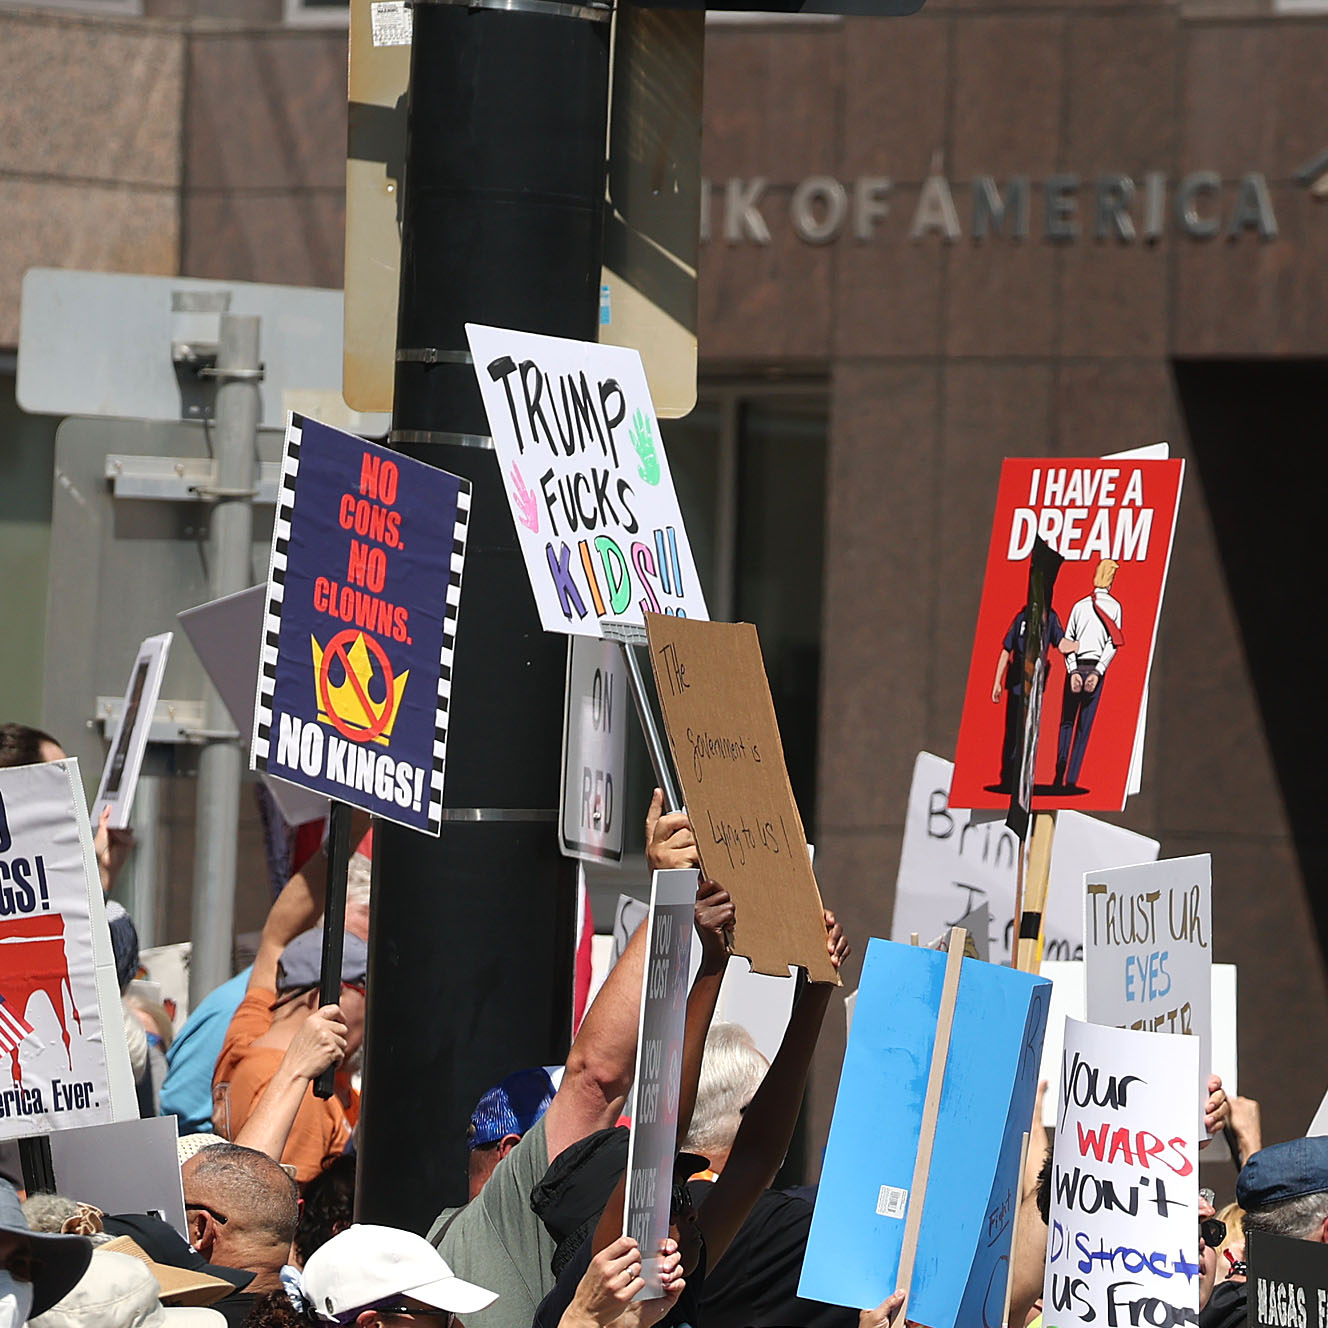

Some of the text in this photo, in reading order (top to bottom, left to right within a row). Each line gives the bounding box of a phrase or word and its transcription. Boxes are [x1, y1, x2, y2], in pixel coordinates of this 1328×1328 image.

[791, 171, 1279, 243] OF AMERICA
[487, 356, 627, 469] TRUMP
[359, 452, 398, 505] NO
[539, 467, 639, 537] FUCKS
[1029, 469, 1143, 506] I HAVE A
[338, 493, 404, 550] CONS.
[1007, 508, 1154, 561] DREAM
[348, 538, 385, 593] NO
[545, 526, 687, 620] KIDS!!
[313, 576, 413, 645] CLOWNS.
[593, 667, 614, 734] ON
[276, 711, 425, 812] NO KINGS!
[748, 740, 761, 763] is
[581, 766, 614, 834] RED
[655, 914, 672, 955] YOU
[1088, 884, 1162, 947] TRUST
[1170, 884, 1208, 949] UR
[650, 959, 670, 1000] LOST
[1126, 951, 1172, 1003] EYES
[645, 1040, 662, 1081] YOU
[52, 1078, 101, 1110] Ever.
[639, 1084, 660, 1125] LOST
[1077, 1120, 1194, 1177] WARS
[630, 1168, 657, 1210] YOU'RE
[631, 1212, 650, 1252] NEXT
